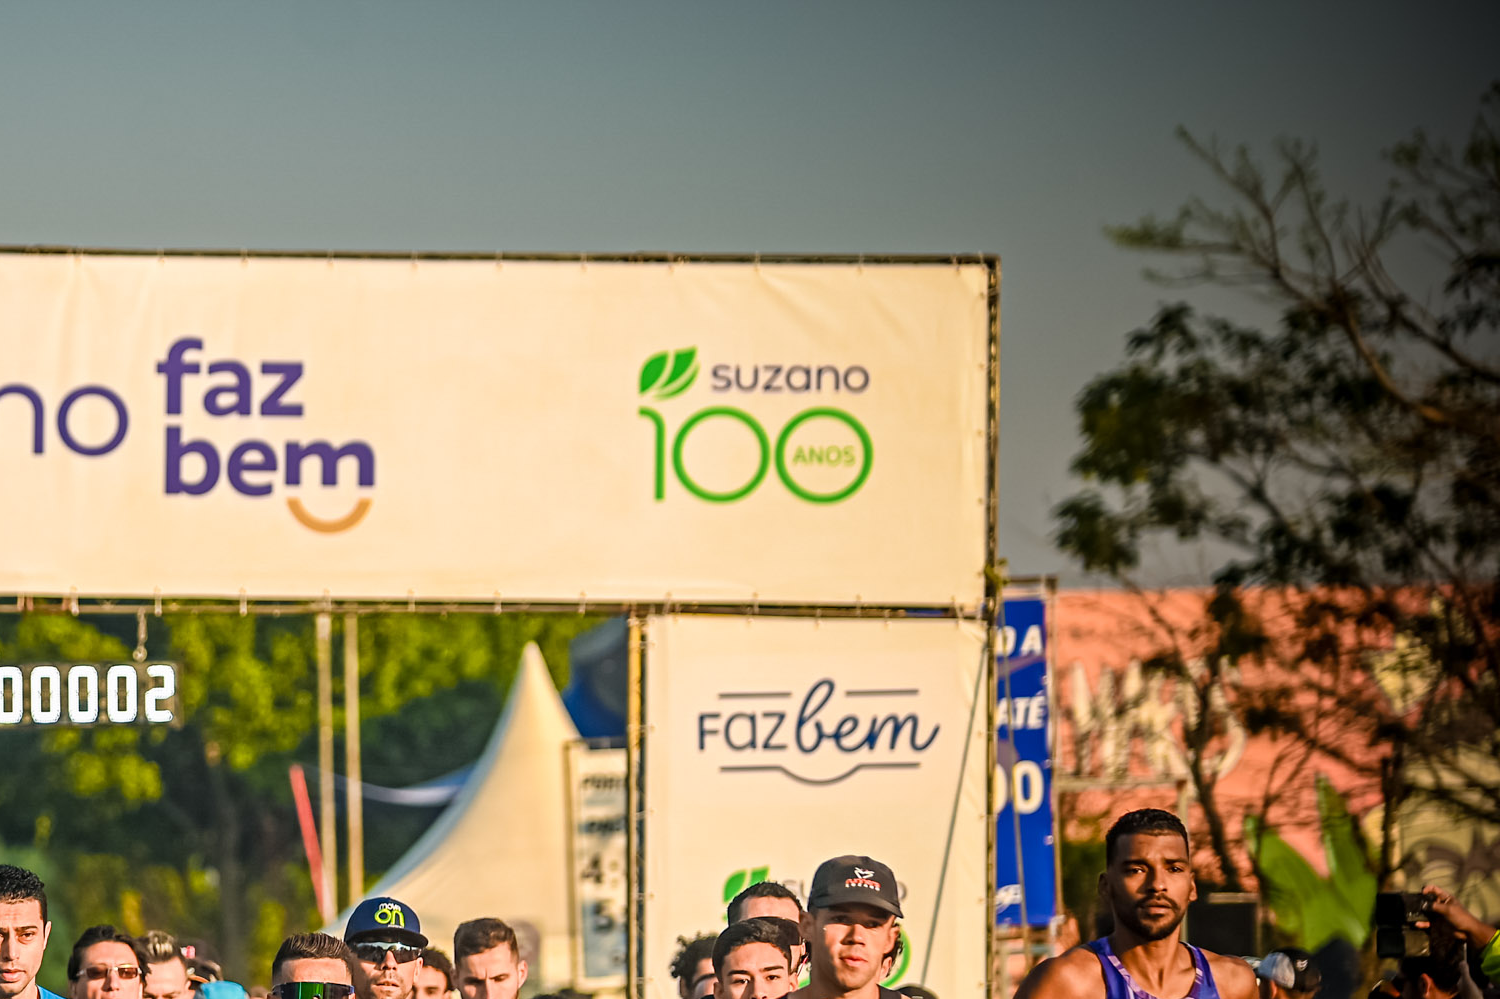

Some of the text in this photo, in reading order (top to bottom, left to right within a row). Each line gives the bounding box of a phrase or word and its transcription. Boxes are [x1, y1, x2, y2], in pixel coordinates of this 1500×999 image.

[157, 337, 304, 417] faz
[711, 363, 870, 394] suzano
[164, 424, 377, 497] bem
[638, 406, 874, 505] 100
[792, 446, 855, 466] ANOS
[794, 677, 941, 755] bem
